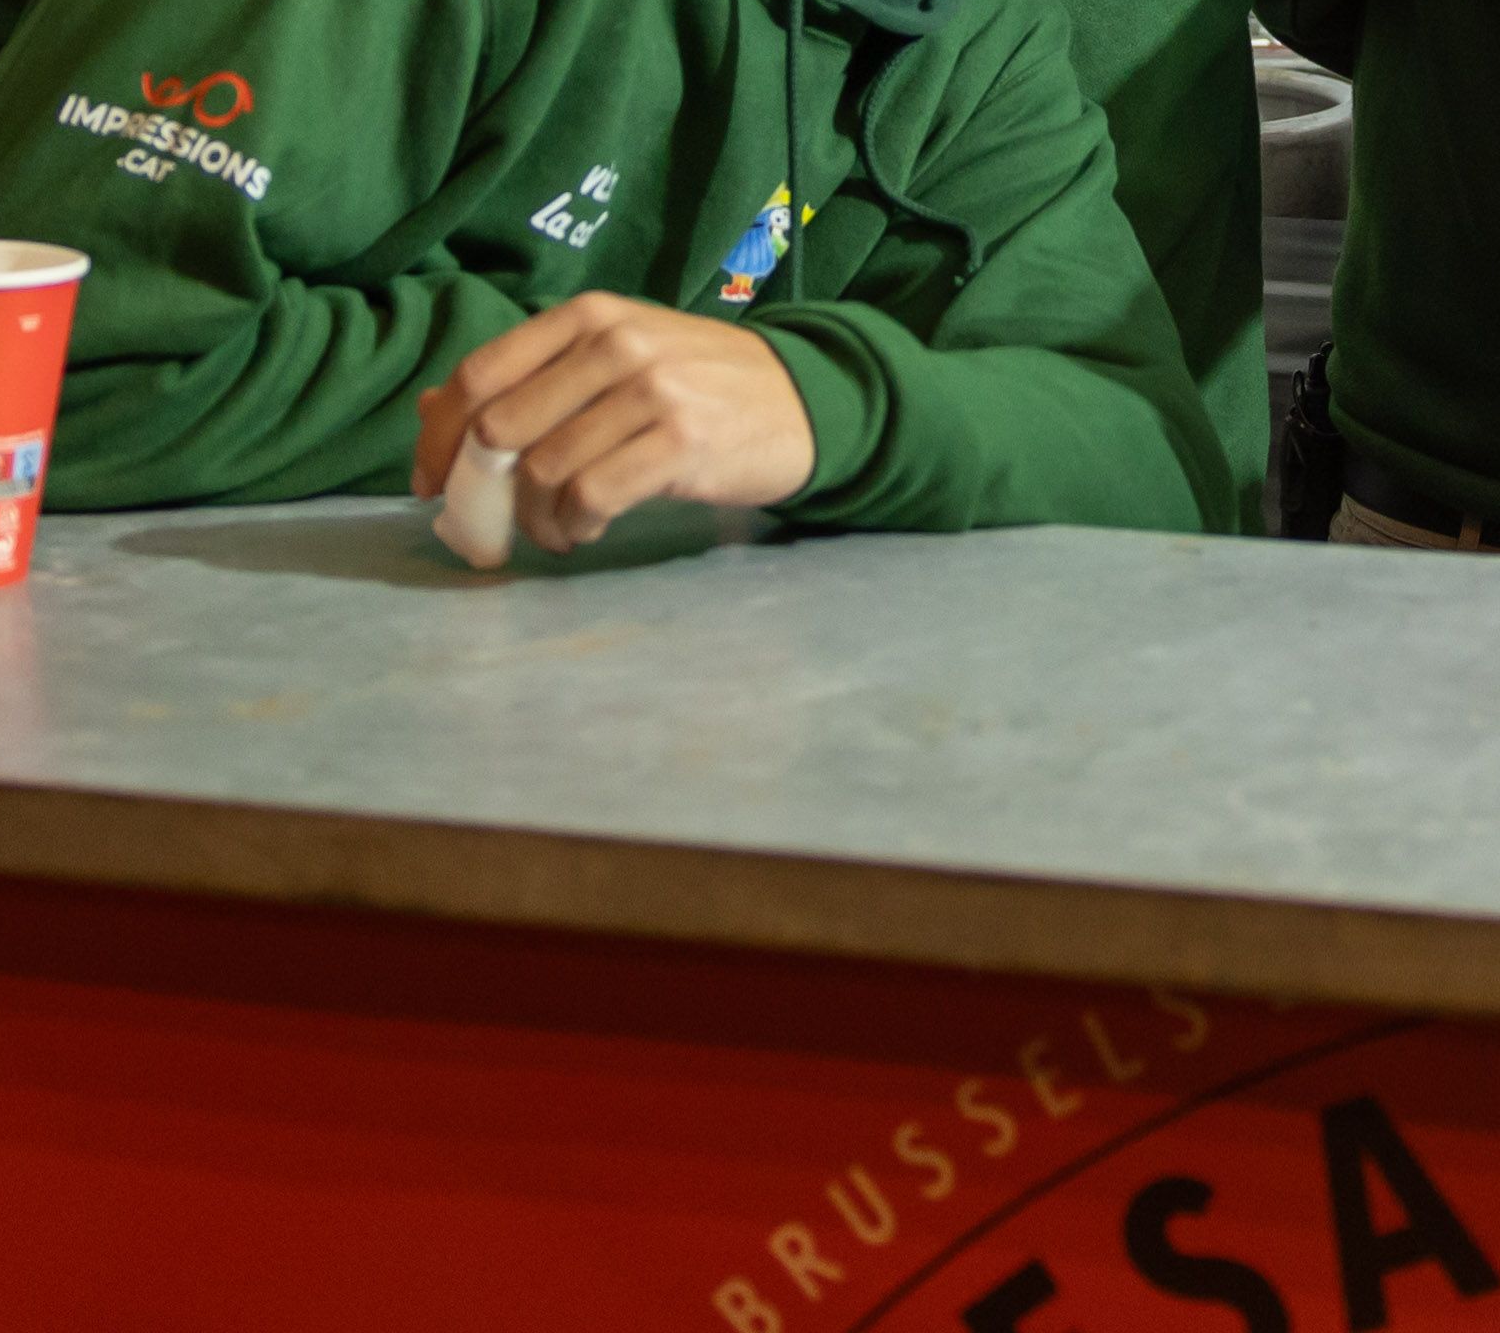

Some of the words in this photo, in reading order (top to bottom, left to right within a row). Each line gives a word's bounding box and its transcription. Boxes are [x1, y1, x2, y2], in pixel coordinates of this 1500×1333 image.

[58, 92, 273, 201] IMPRESSIONS
[115, 148, 177, 183] .CAT
[711, 985, 1211, 1333] BRUSSELS
